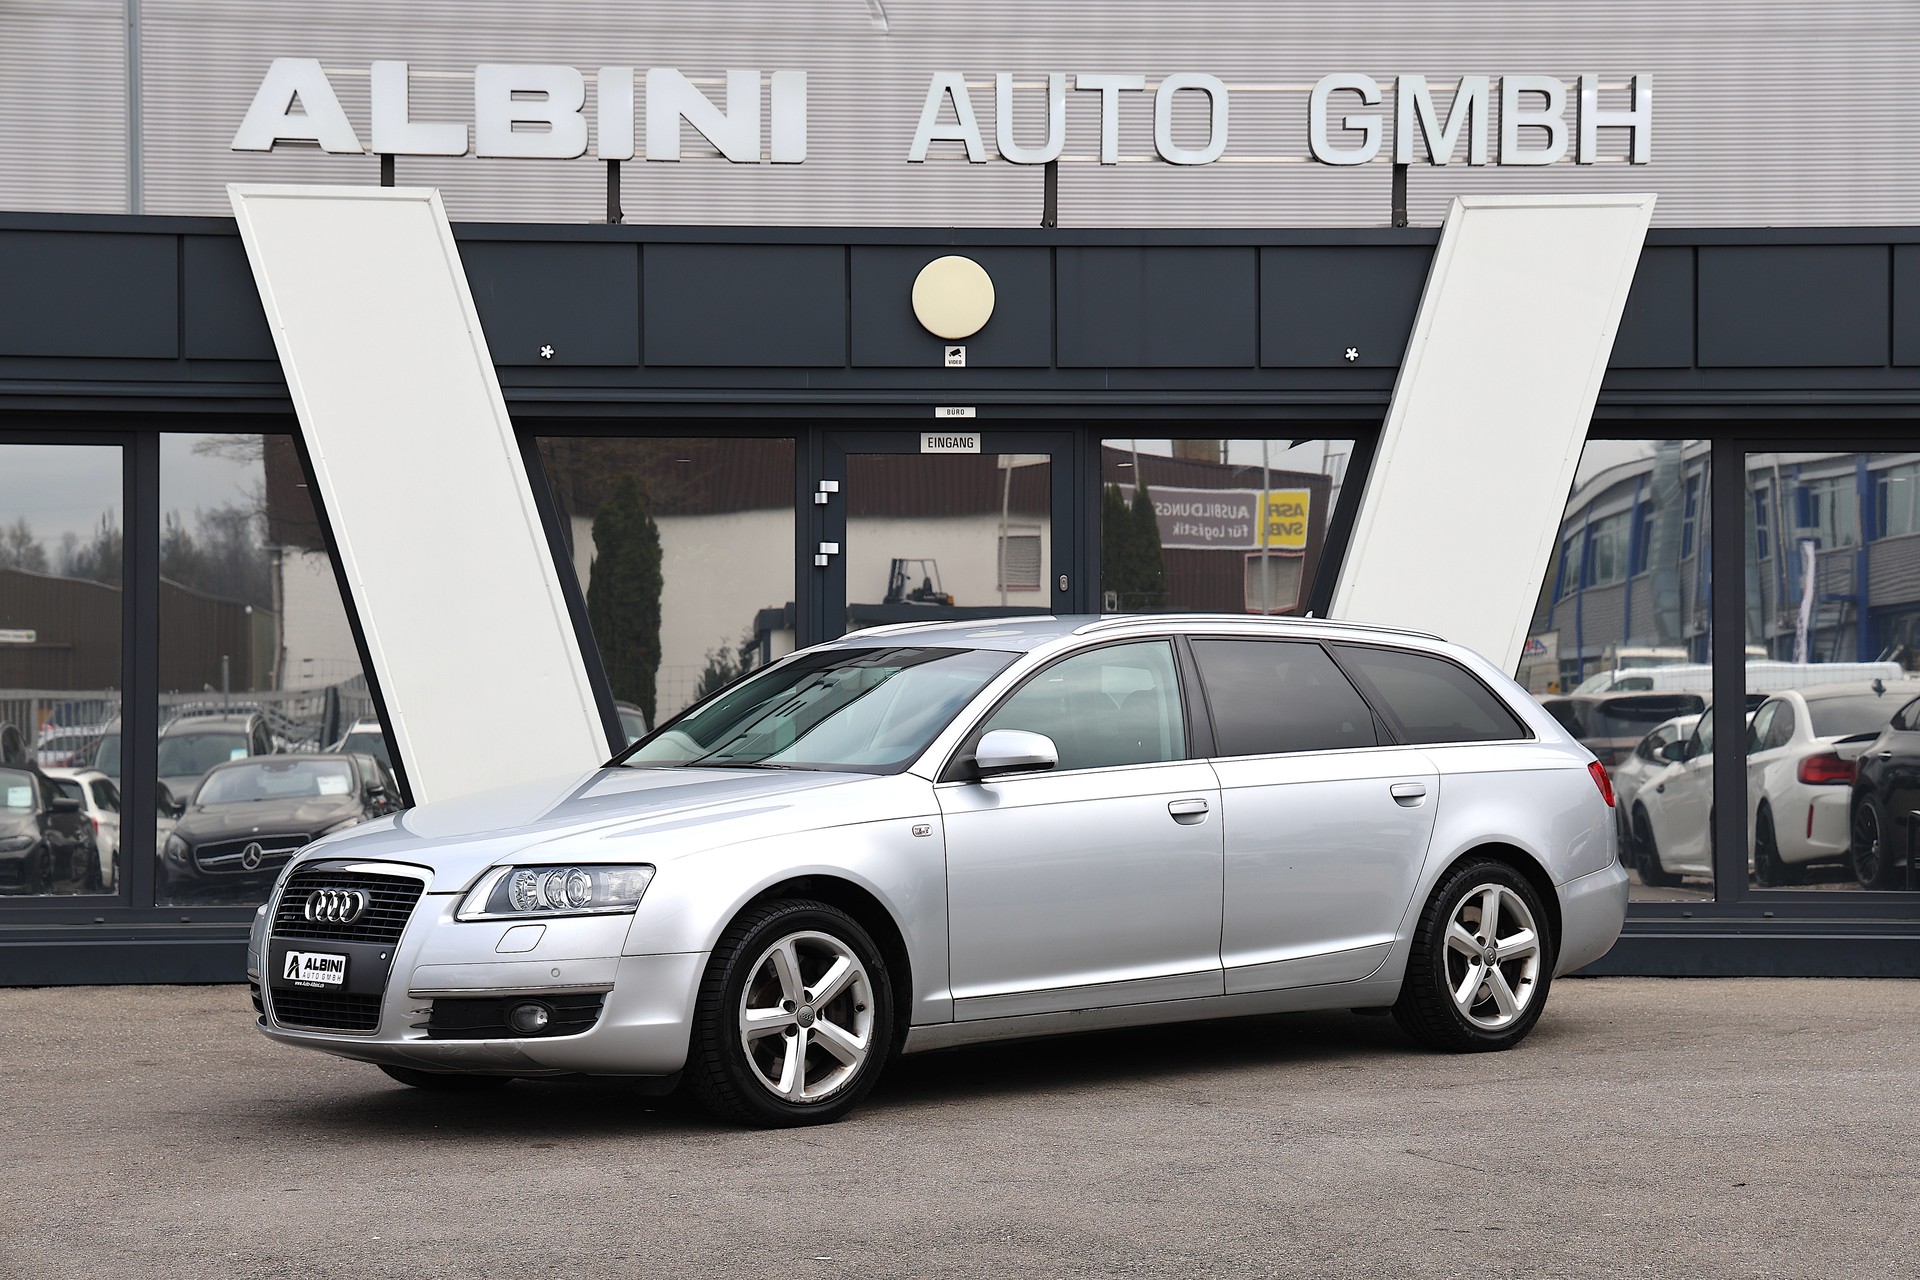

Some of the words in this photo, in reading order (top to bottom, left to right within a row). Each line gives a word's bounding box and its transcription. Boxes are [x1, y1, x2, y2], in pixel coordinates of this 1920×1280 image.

[231, 57, 808, 164] ALBINI
[907, 72, 1228, 166] AUTO
[1308, 73, 1654, 167] GMBH
[946, 407, 965, 415] BÜRO
[928, 437, 974, 448] EINGANG
[304, 957, 343, 973] ALBINI
[303, 971, 320, 980] AUTO
[322, 973, 342, 982] GMBH
